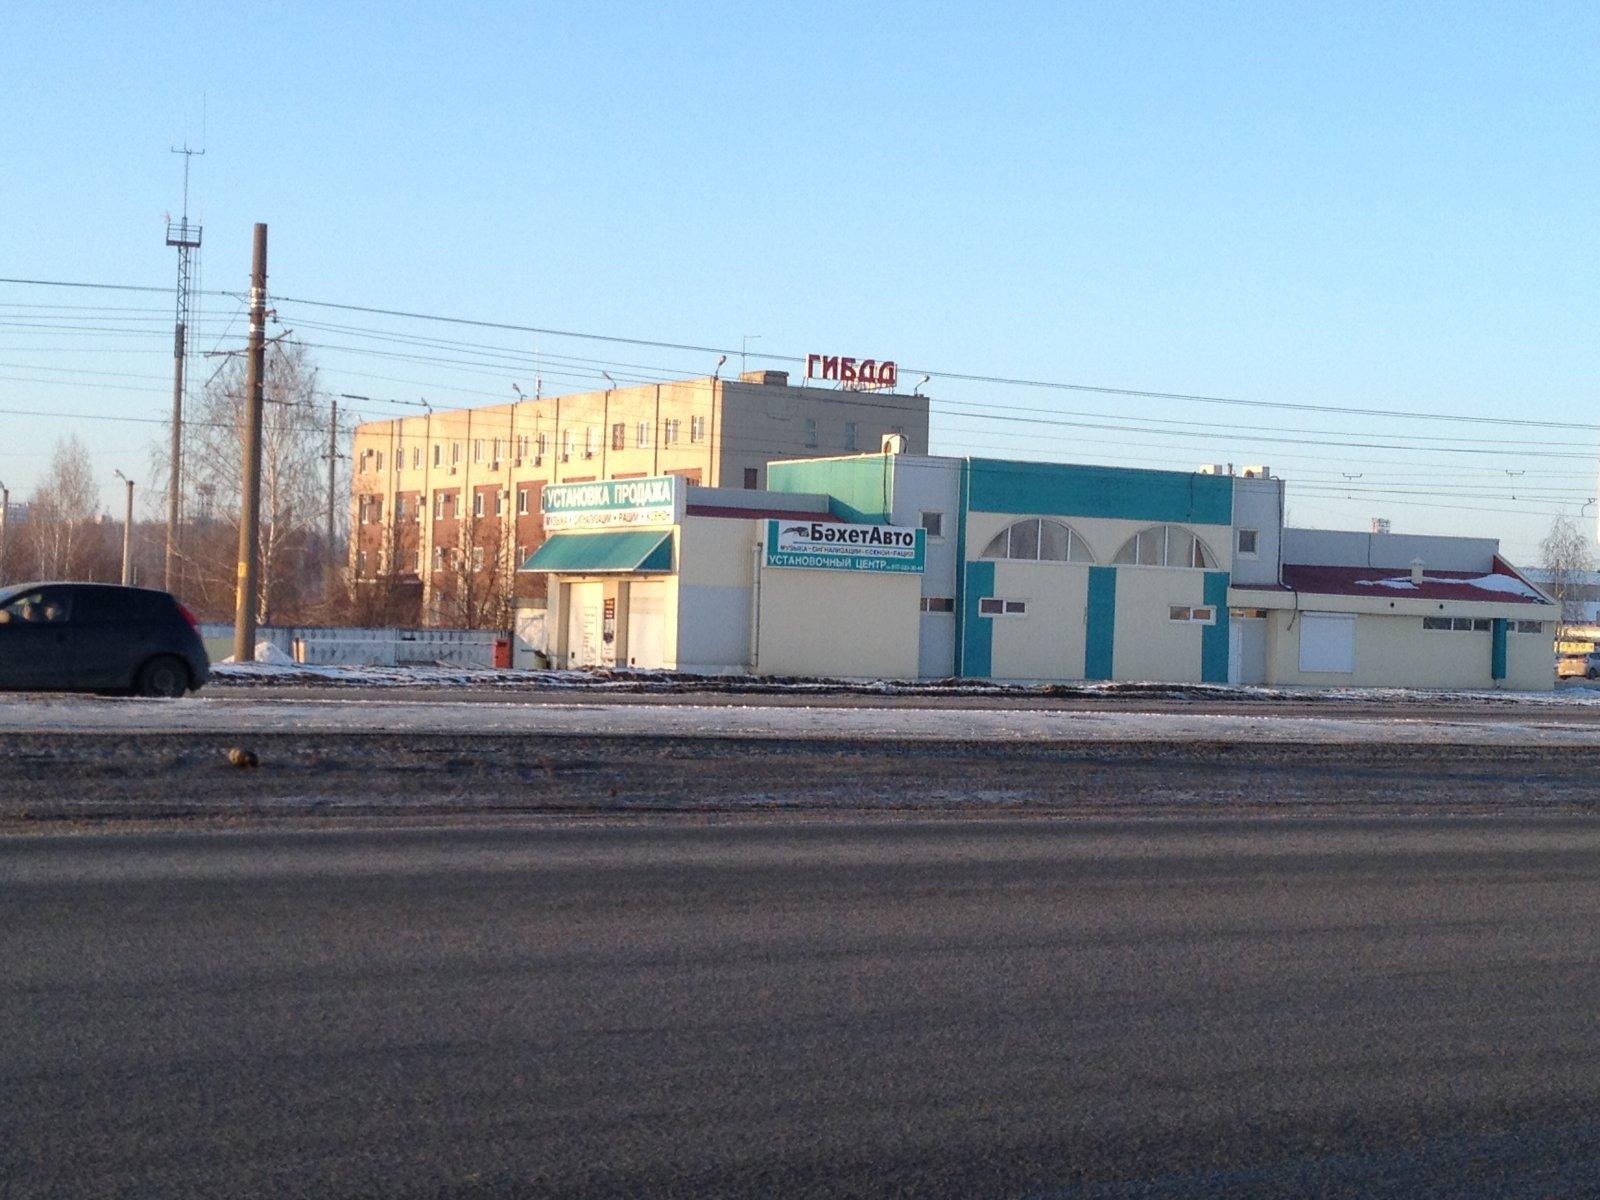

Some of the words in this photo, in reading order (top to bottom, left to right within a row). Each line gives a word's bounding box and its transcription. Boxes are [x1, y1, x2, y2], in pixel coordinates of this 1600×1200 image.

[808, 354, 896, 385] ГИБДД
[547, 485, 610, 507] УСТАНОВКА
[614, 481, 670, 506] ПРОДАЖА
[769, 555, 852, 567] УСТАНОВОЧНЫЙ
[855, 559, 887, 571] ЦЕНТР
